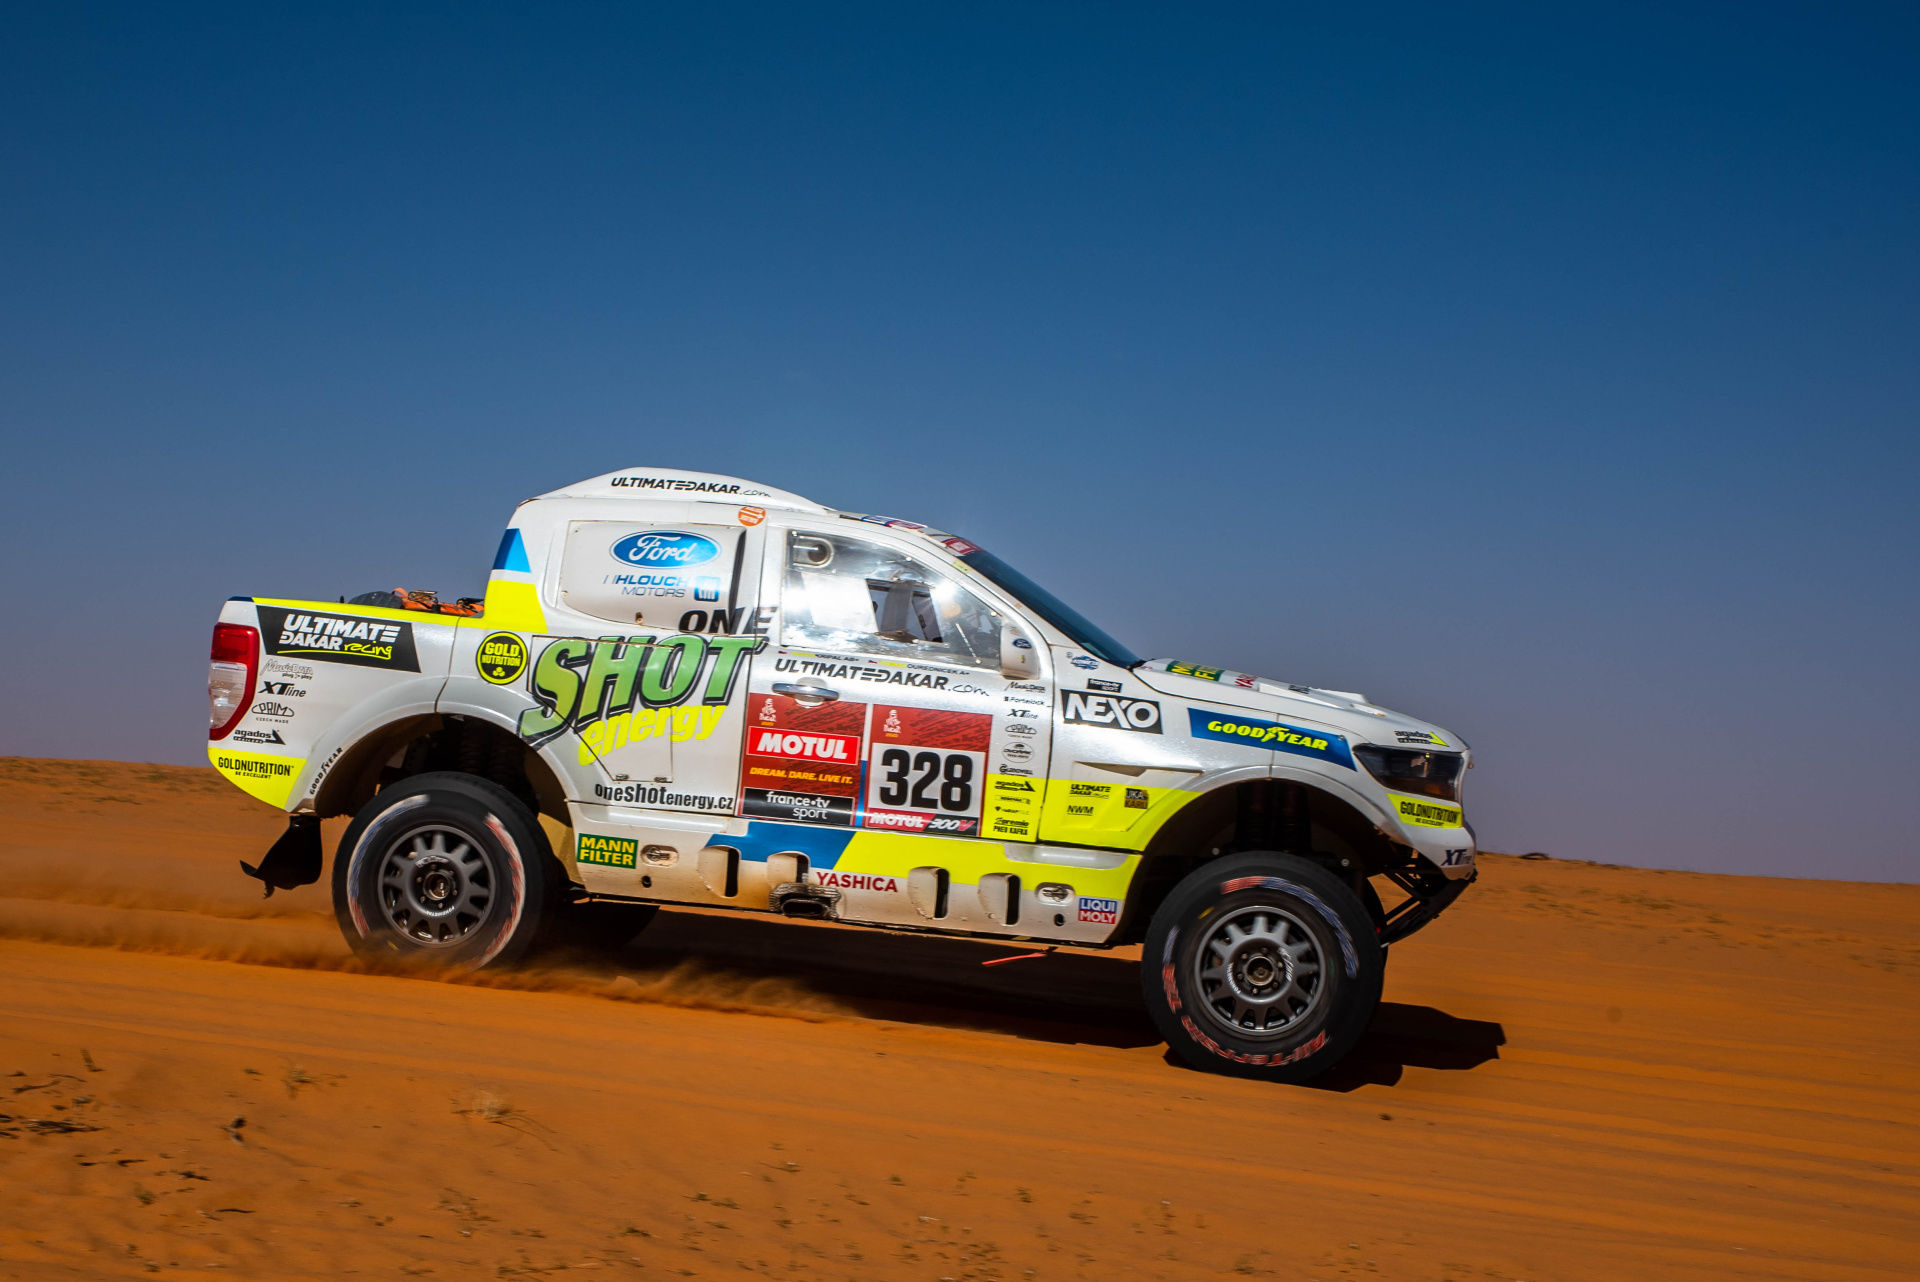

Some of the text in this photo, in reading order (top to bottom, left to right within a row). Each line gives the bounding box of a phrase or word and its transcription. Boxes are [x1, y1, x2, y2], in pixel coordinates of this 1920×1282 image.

[628, 535, 695, 562] Ford
[621, 586, 686, 598] MOTORS
[282, 613, 401, 643] ULTIMATE
[678, 606, 778, 635] ONE
[279, 632, 393, 660] DAKAR racing
[485, 642, 520, 657] GOLD
[481, 654, 521, 667] NUTRITION
[516, 634, 769, 749] SHOT
[1064, 693, 1159, 730] NEXO
[234, 729, 272, 739] agados
[578, 705, 729, 766] energy
[756, 732, 848, 760] MOTUL
[749, 766, 786, 778] DREAM.
[788, 770, 817, 781] DARE.
[819, 773, 840, 783] LIVE
[879, 748, 973, 812] 328
[594, 782, 734, 811] oneshotenergy.cz
[793, 806, 828, 821] sport
[869, 812, 925, 830] MOTUL
[580, 836, 635, 854] MANN
[579, 850, 634, 866] FILTER
[816, 871, 898, 893] YASHICA
[1080, 898, 1117, 912] LIQUI
[1079, 910, 1117, 924] MOLY
